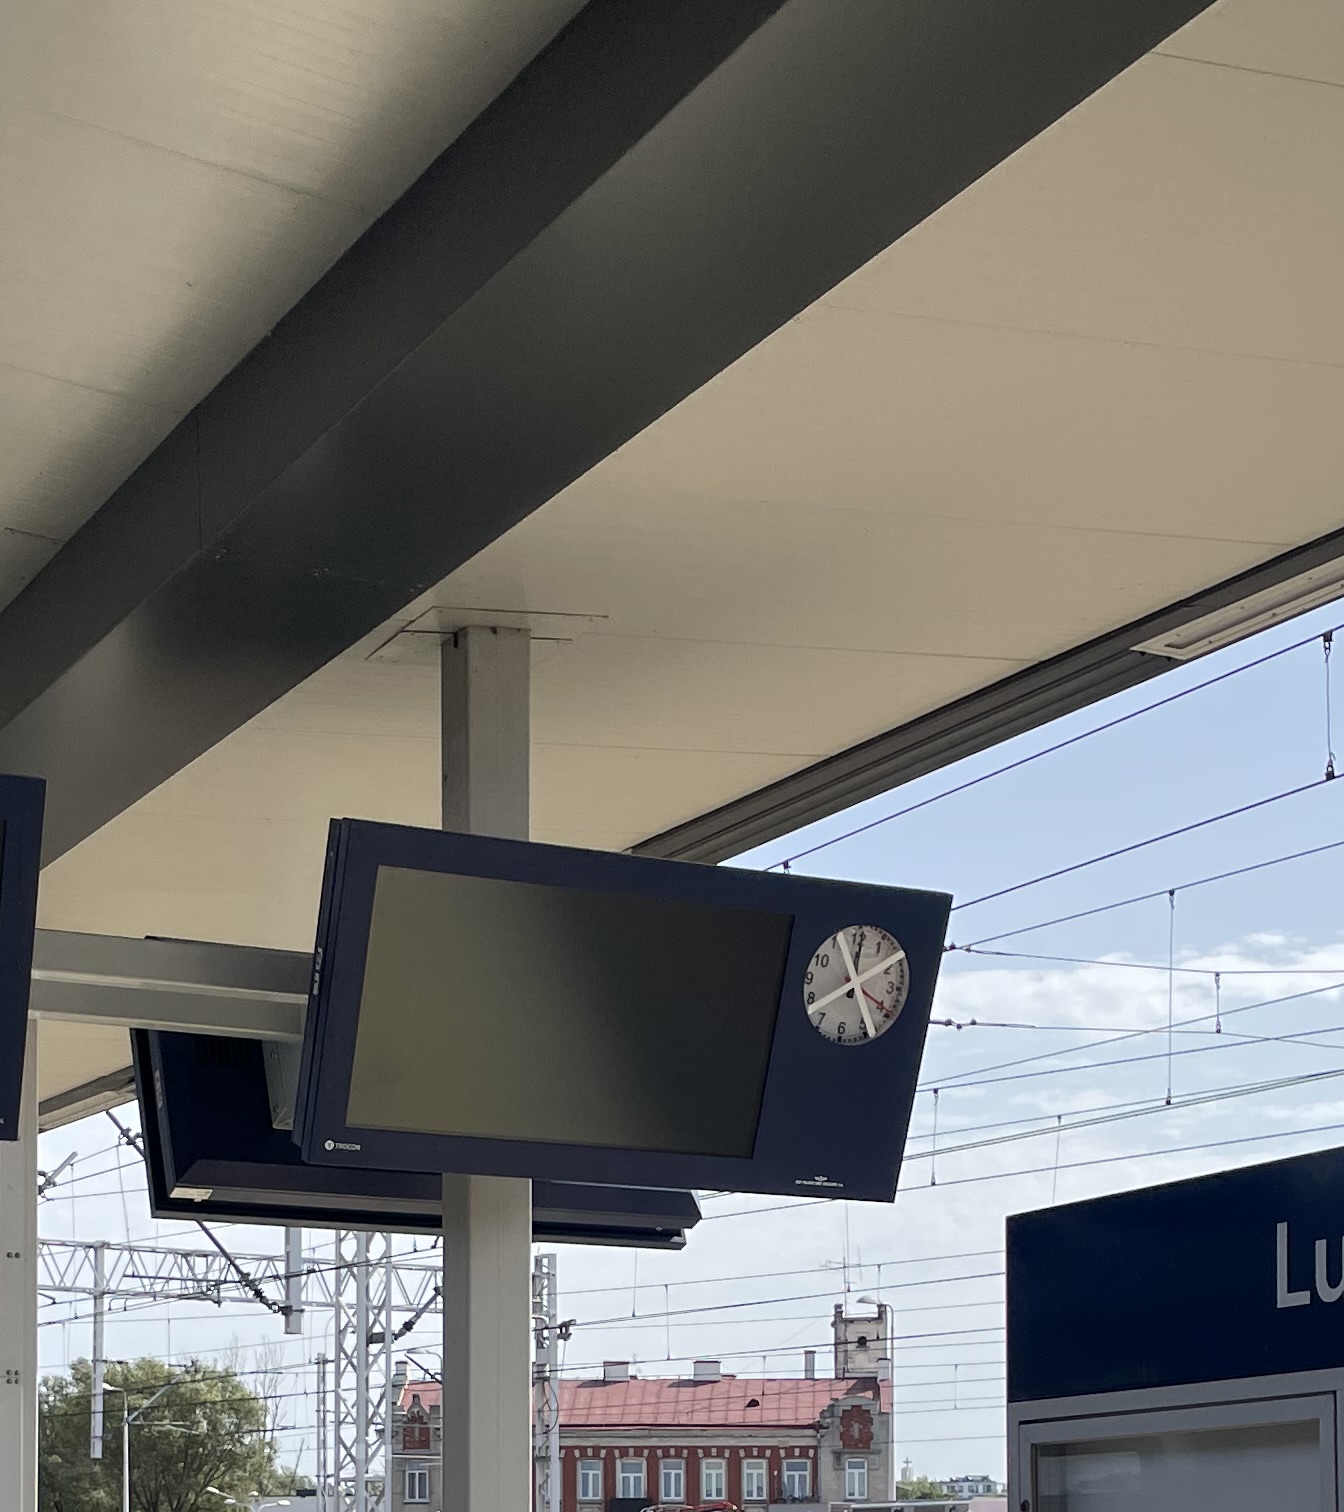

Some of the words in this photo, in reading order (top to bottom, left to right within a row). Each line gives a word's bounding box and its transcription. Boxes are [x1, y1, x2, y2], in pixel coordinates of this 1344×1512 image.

[876, 940, 882, 955] 1
[814, 953, 830, 968] 10
[805, 971, 814, 986] 9
[885, 981, 895, 995] 3
[806, 991, 816, 1005] 8
[818, 1012, 826, 1026] 7
[837, 1022, 847, 1035] 6
